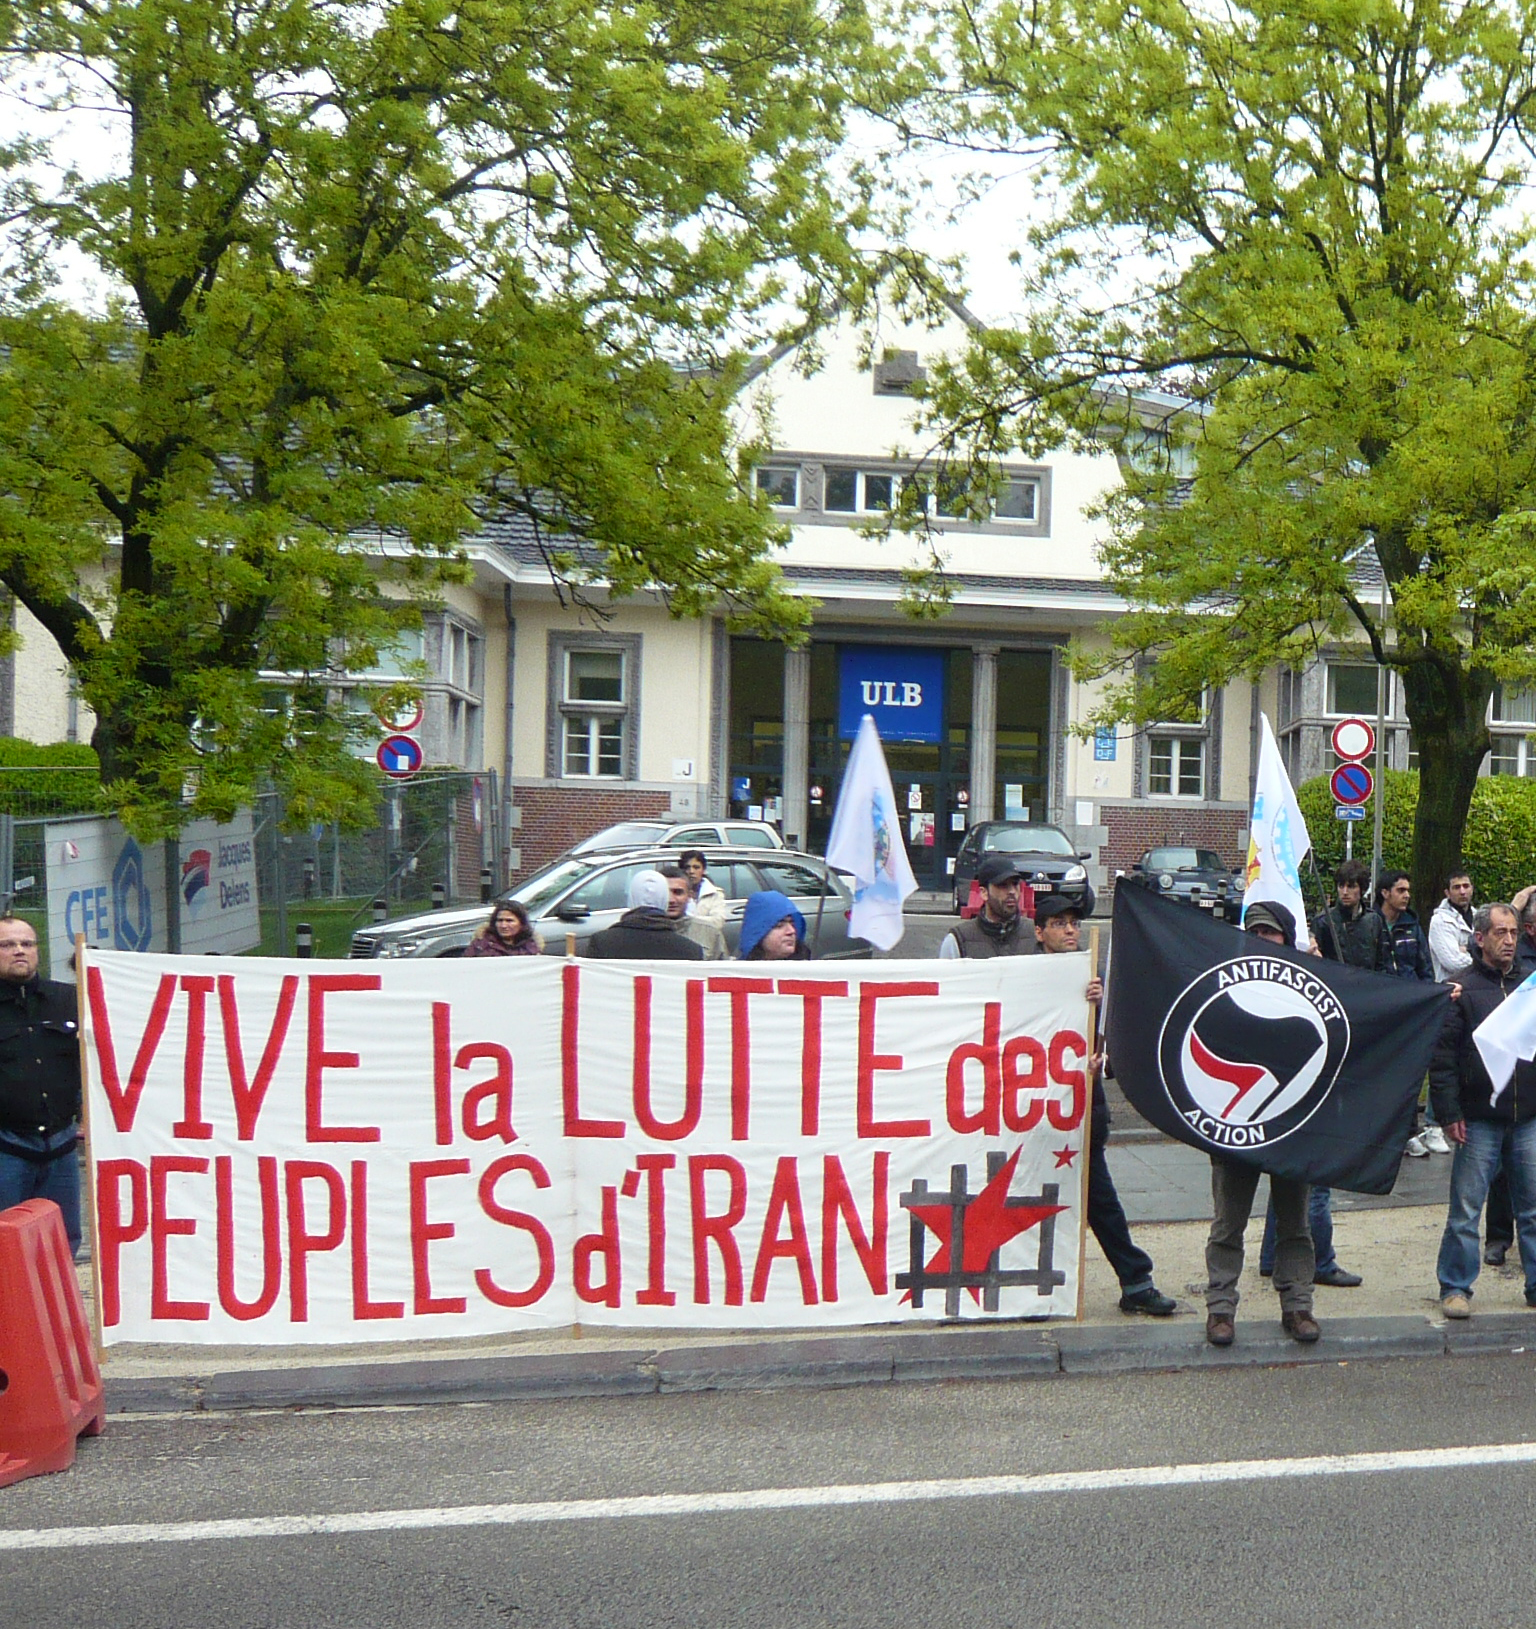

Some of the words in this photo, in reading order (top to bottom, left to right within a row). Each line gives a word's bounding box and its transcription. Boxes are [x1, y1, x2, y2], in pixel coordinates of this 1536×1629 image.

[861, 680, 922, 707] ULB
[682, 762, 692, 776] J
[65, 886, 110, 947] CFE
[1218, 961, 1341, 1021] ANTIFASCIST
[87, 966, 382, 1142] VIVE
[432, 1001, 519, 1145] la
[561, 965, 940, 1141] LUTTE
[946, 1002, 1087, 1136] des
[1184, 1108, 1266, 1145] ACTION
[97, 1154, 556, 1328] PEUPLES
[573, 1151, 892, 1308] d'IRAN
